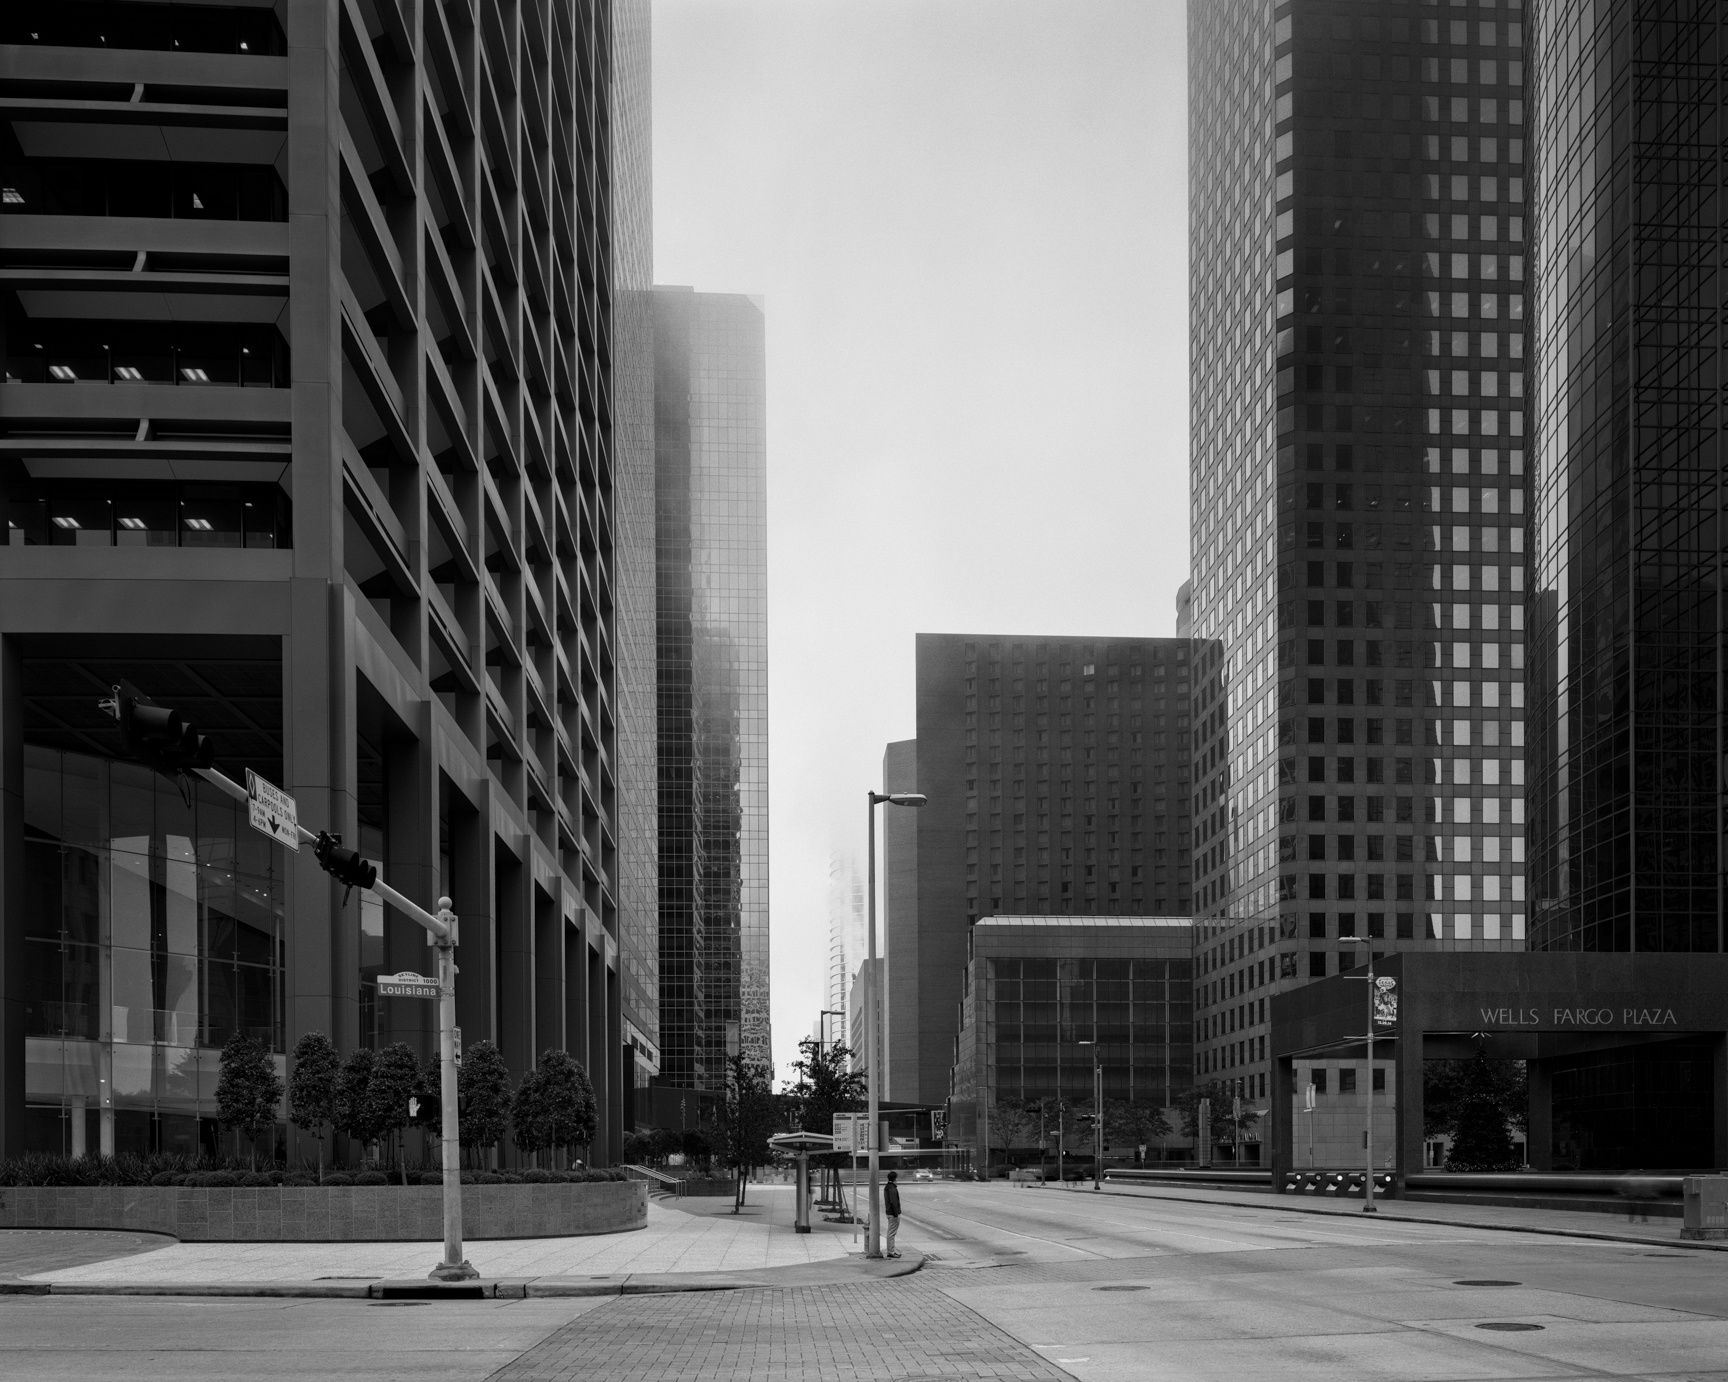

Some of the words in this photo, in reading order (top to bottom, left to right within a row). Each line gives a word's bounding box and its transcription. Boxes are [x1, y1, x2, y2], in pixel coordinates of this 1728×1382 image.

[262, 782, 278, 801] BUSES
[280, 795, 290, 808] AND
[252, 803, 266, 818] 7-9AM
[258, 793, 283, 817] CARPOOLS
[284, 810, 296, 825] ONLY
[253, 815, 267, 829] 4-6PM
[281, 826, 297, 841] MON-FRI
[380, 984, 436, 996] Louisiana
[1480, 1008, 1539, 1025] WELLS
[1554, 1008, 1614, 1025] FARGO
[1623, 1008, 1677, 1025] PLAZA
[453, 1029, 461, 1040] ONE
